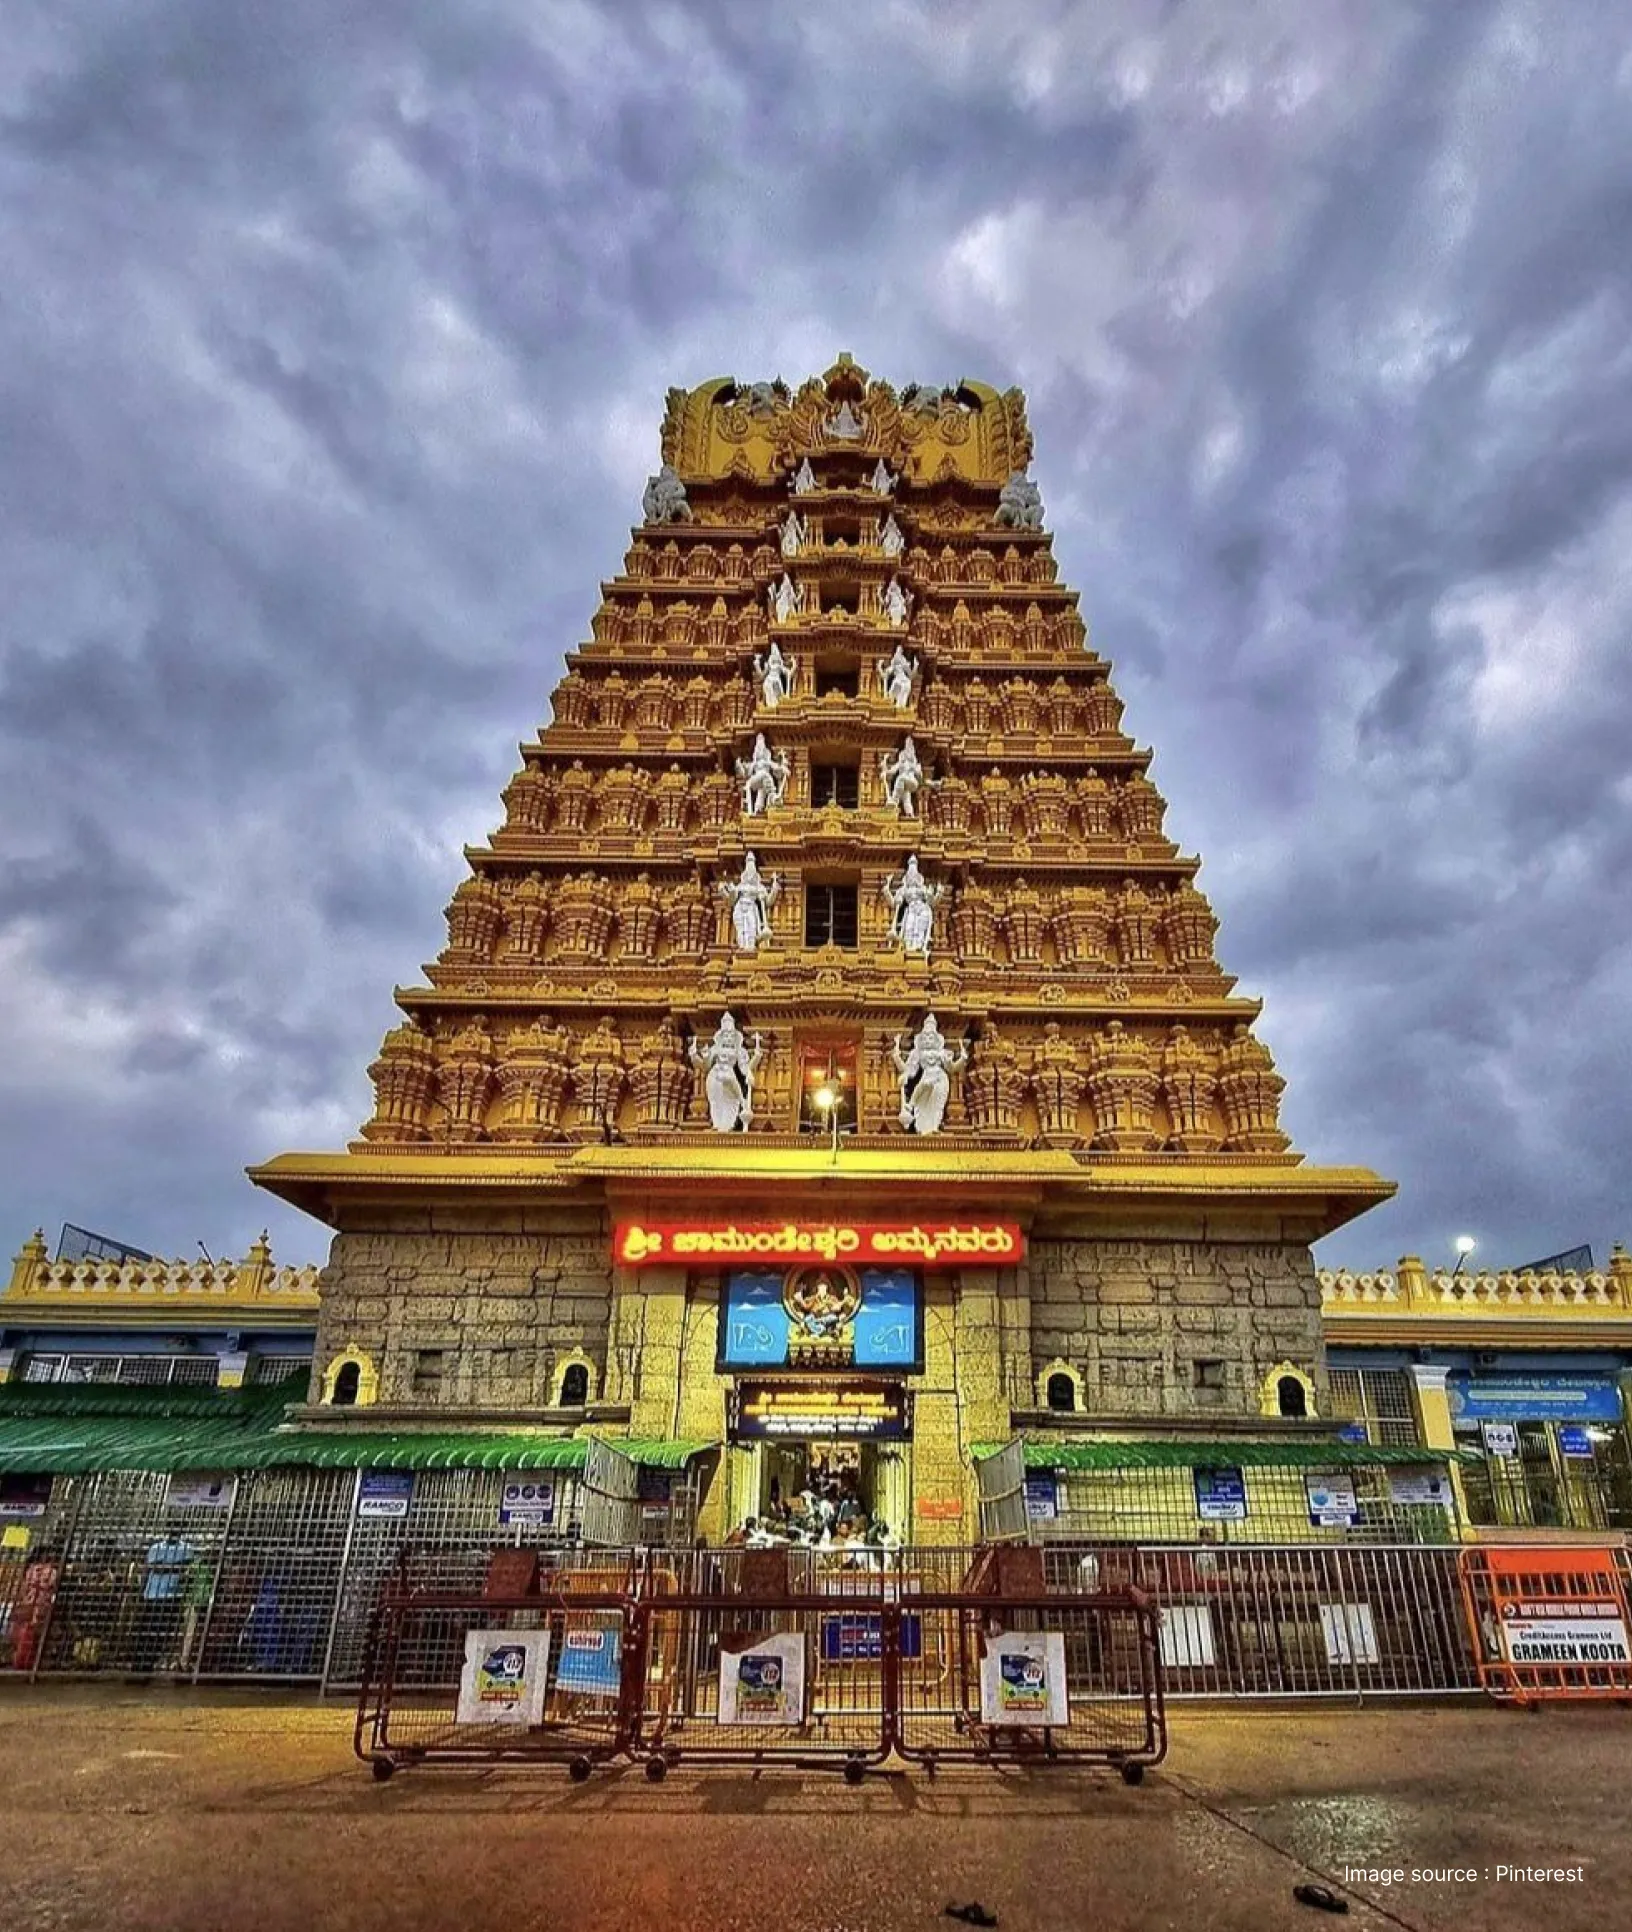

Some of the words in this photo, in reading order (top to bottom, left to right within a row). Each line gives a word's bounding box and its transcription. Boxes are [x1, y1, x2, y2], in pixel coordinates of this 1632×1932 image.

[623, 1226, 662, 1261] ಶ್ರೀ
[673, 1226, 860, 1260] ಚಾಮುಂಡೇಶ್ವರಿ
[871, 1226, 1013, 1260] ಅಮ್ಮನವರು
[1512, 1643, 1578, 1660] GRAMEEN
[1580, 1643, 1627, 1660] KOOTA
